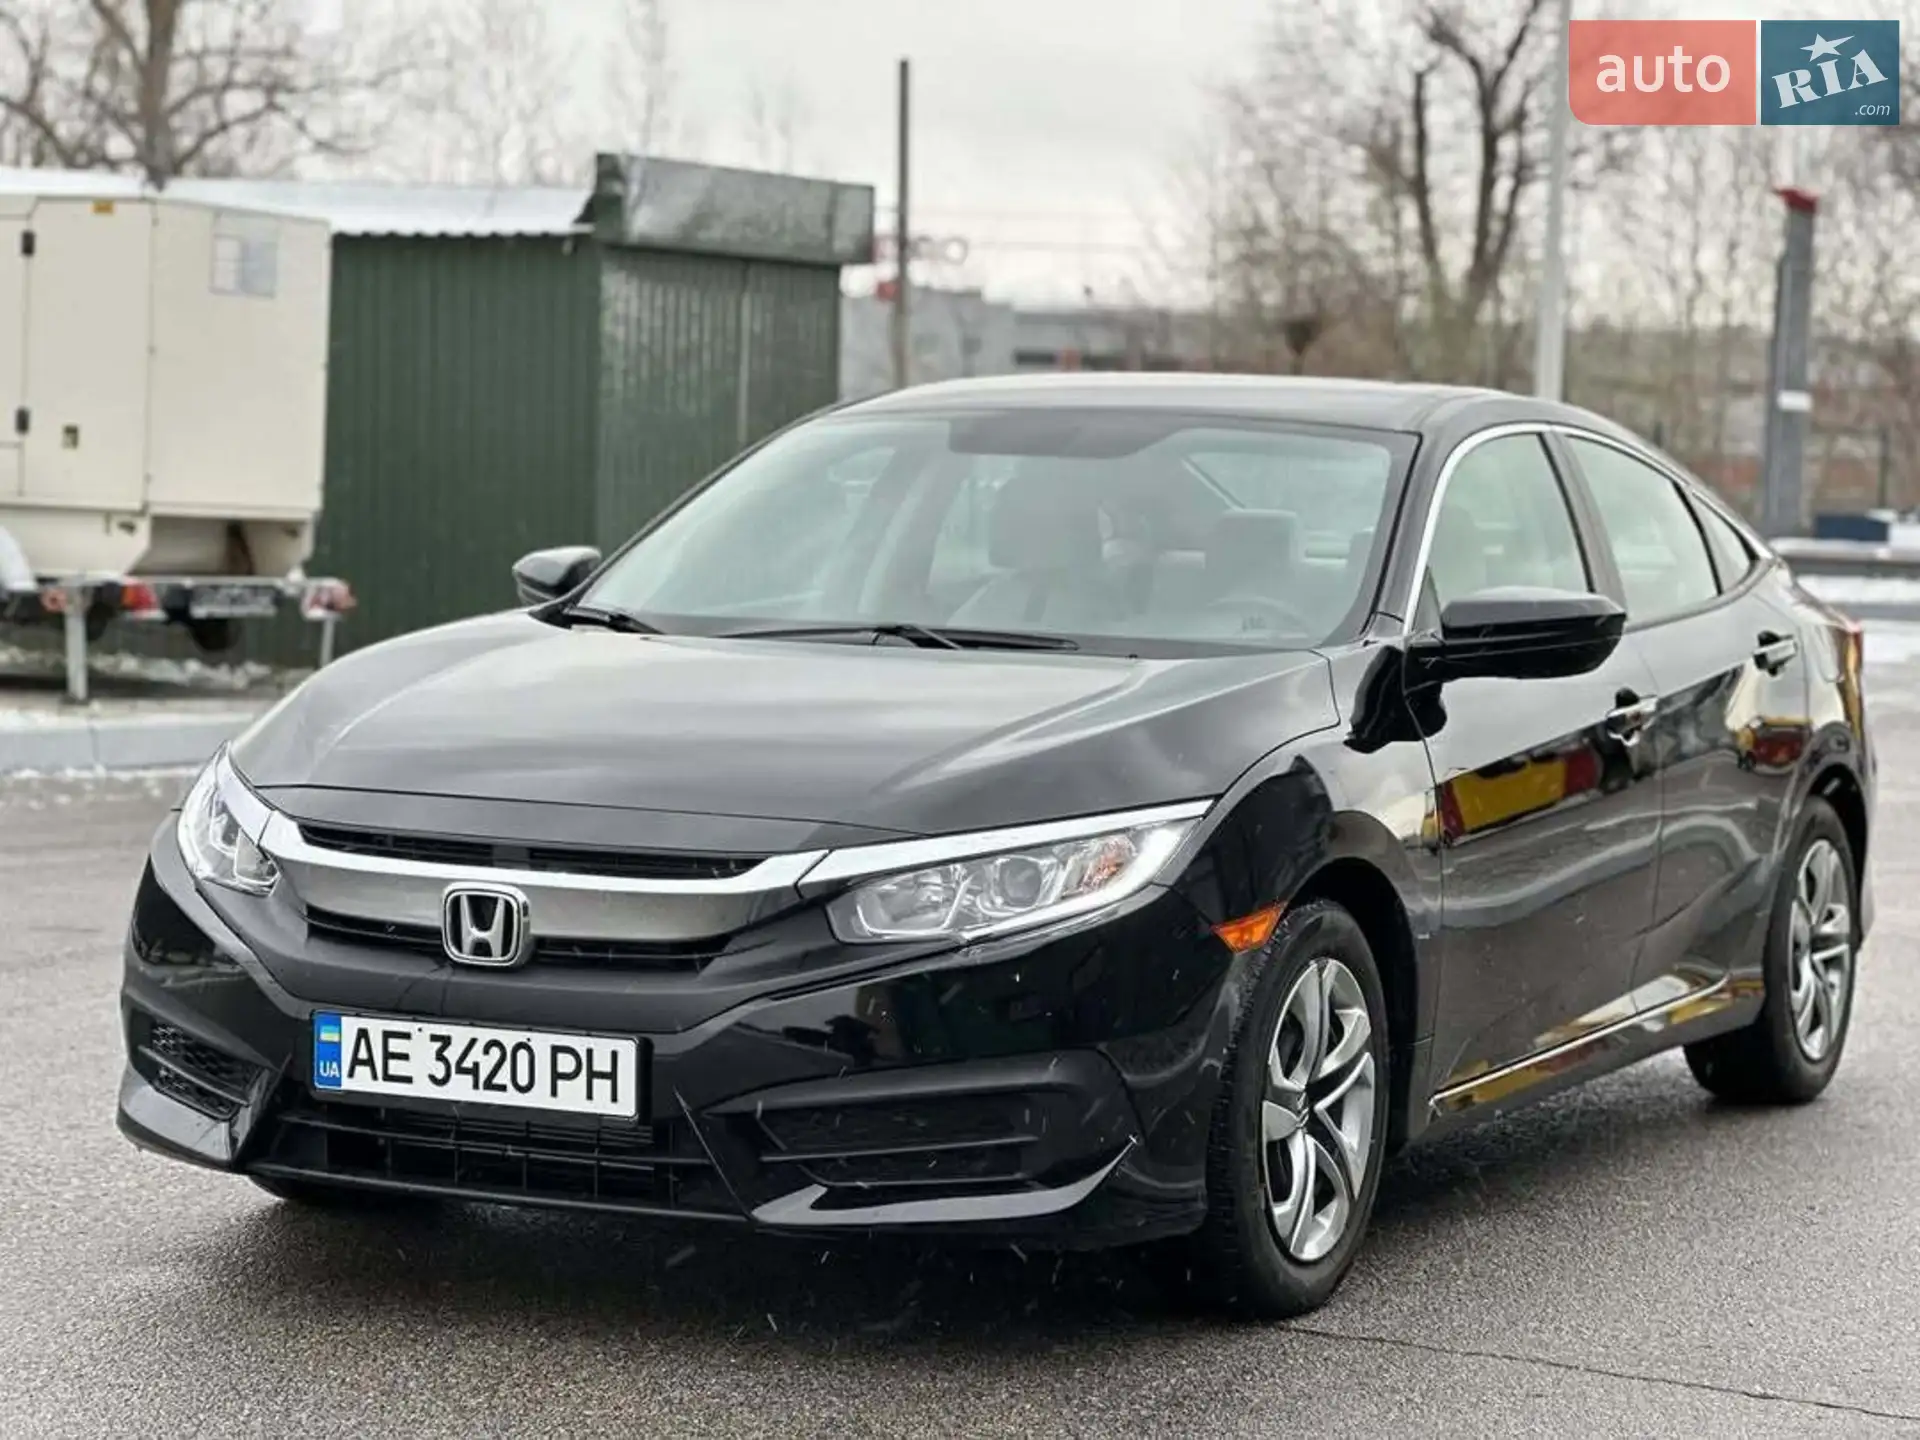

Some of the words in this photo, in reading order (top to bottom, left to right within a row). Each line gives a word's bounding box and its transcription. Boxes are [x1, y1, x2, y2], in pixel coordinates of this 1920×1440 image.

[319, 1060, 340, 1078] UA
[347, 1027, 413, 1084] AE
[428, 1033, 536, 1094] 3420
[550, 1044, 618, 1103] PH
